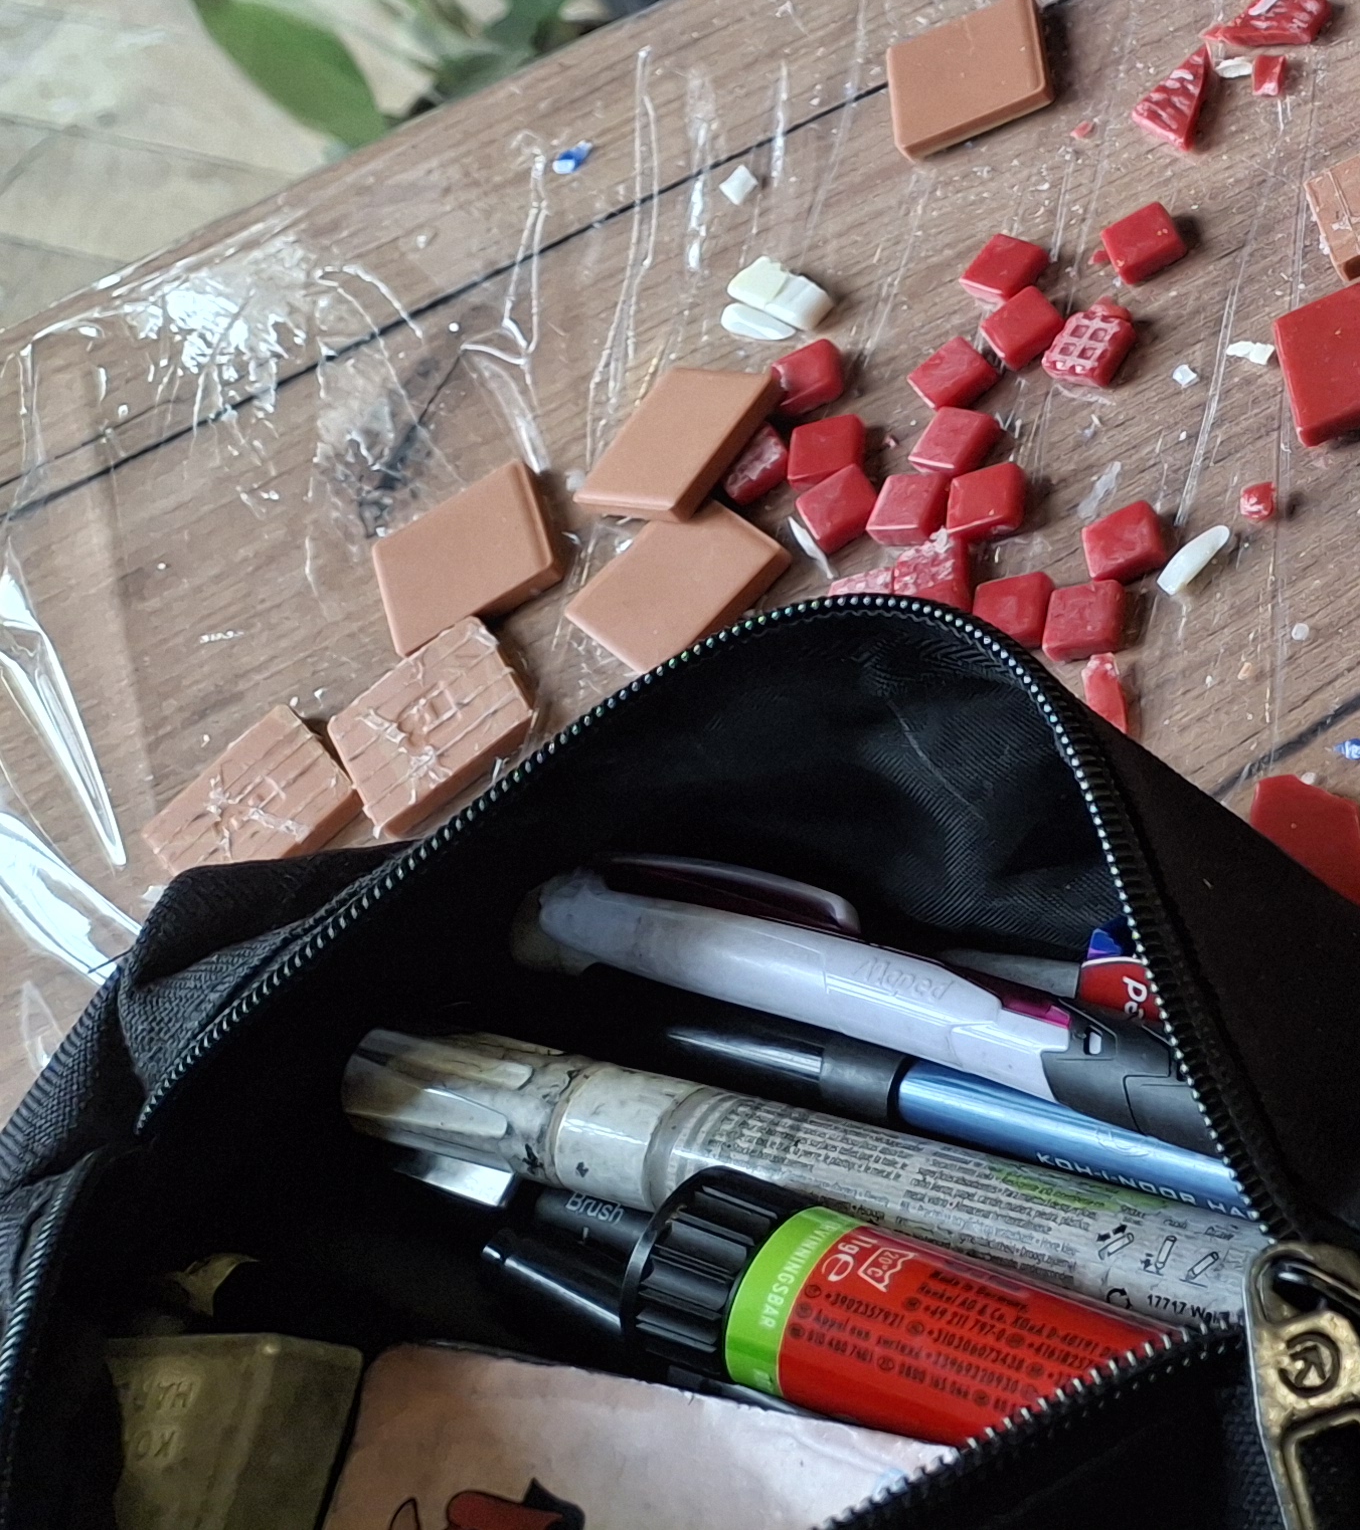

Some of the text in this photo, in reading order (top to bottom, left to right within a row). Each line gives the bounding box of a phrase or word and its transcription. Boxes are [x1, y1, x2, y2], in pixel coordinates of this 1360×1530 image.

[1035, 1151, 1197, 1206] KOH-I-NOOR
[1207, 1199, 1253, 1222] HA
[565, 1190, 625, 1227] Brush
[1147, 1294, 1187, 1315] 17717
